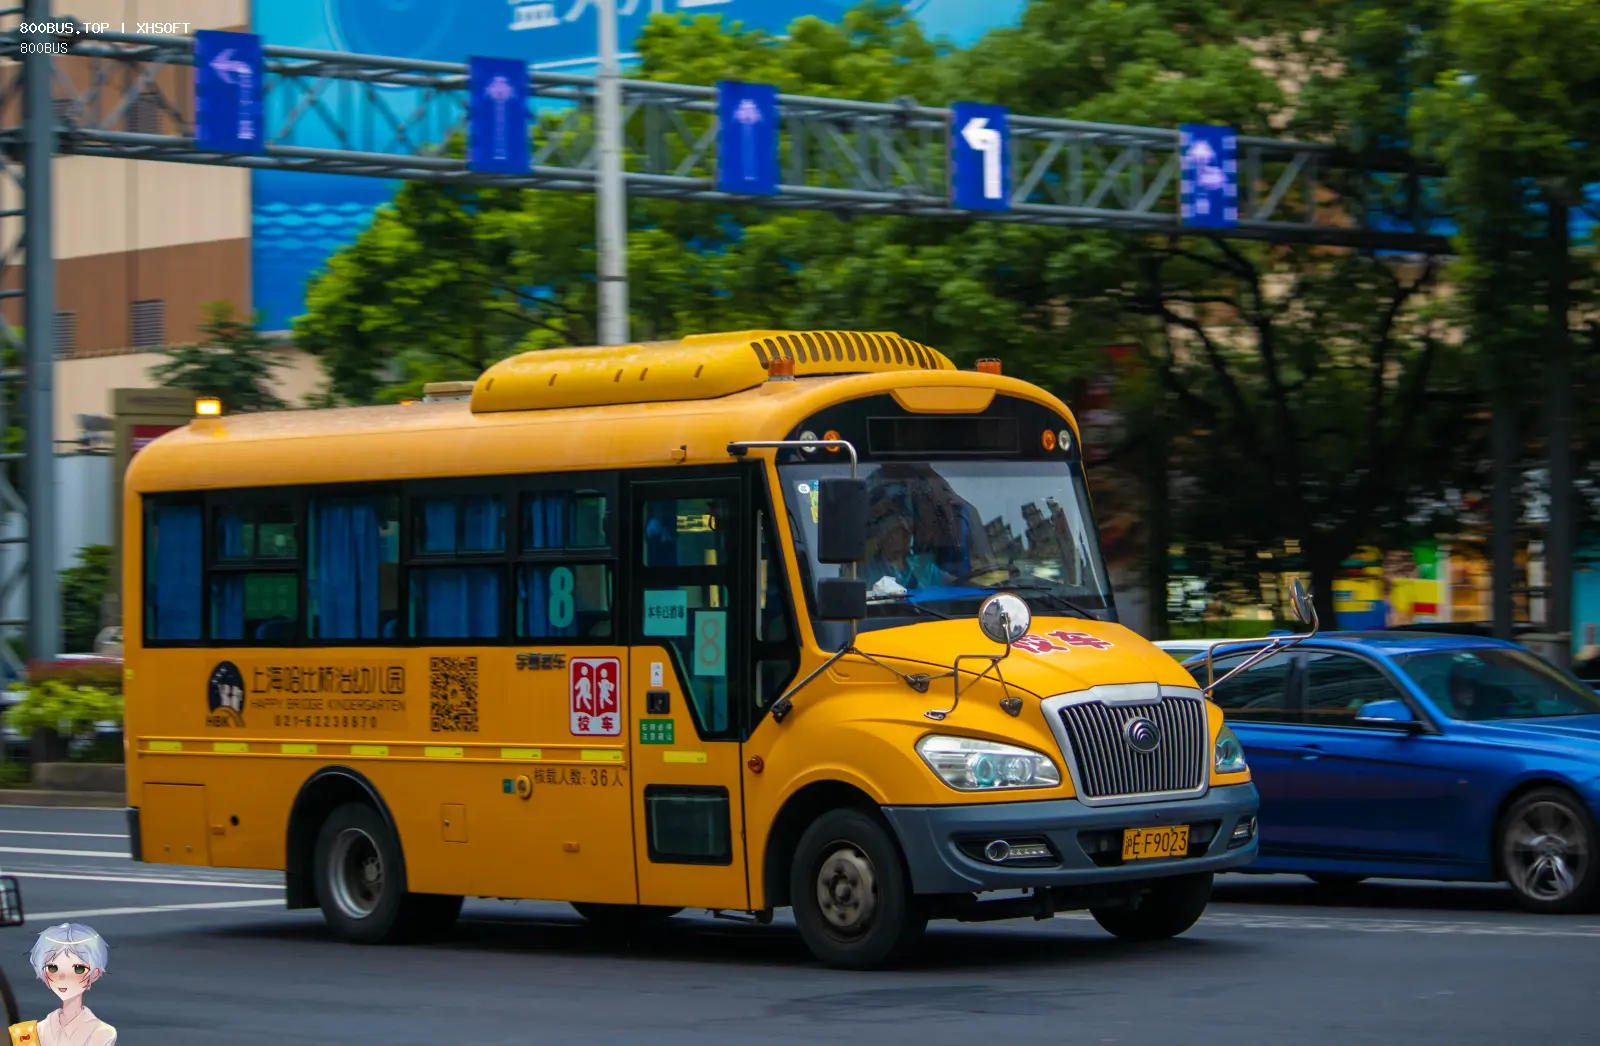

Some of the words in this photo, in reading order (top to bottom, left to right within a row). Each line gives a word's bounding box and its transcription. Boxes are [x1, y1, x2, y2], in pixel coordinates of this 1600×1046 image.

[550, 567, 574, 628] 8
[698, 617, 721, 666] 8
[251, 698, 284, 710] HAPPY
[287, 698, 323, 711] BRIDGE
[328, 699, 406, 712] KINDERGARTEN
[577, 715, 614, 732] 校车
